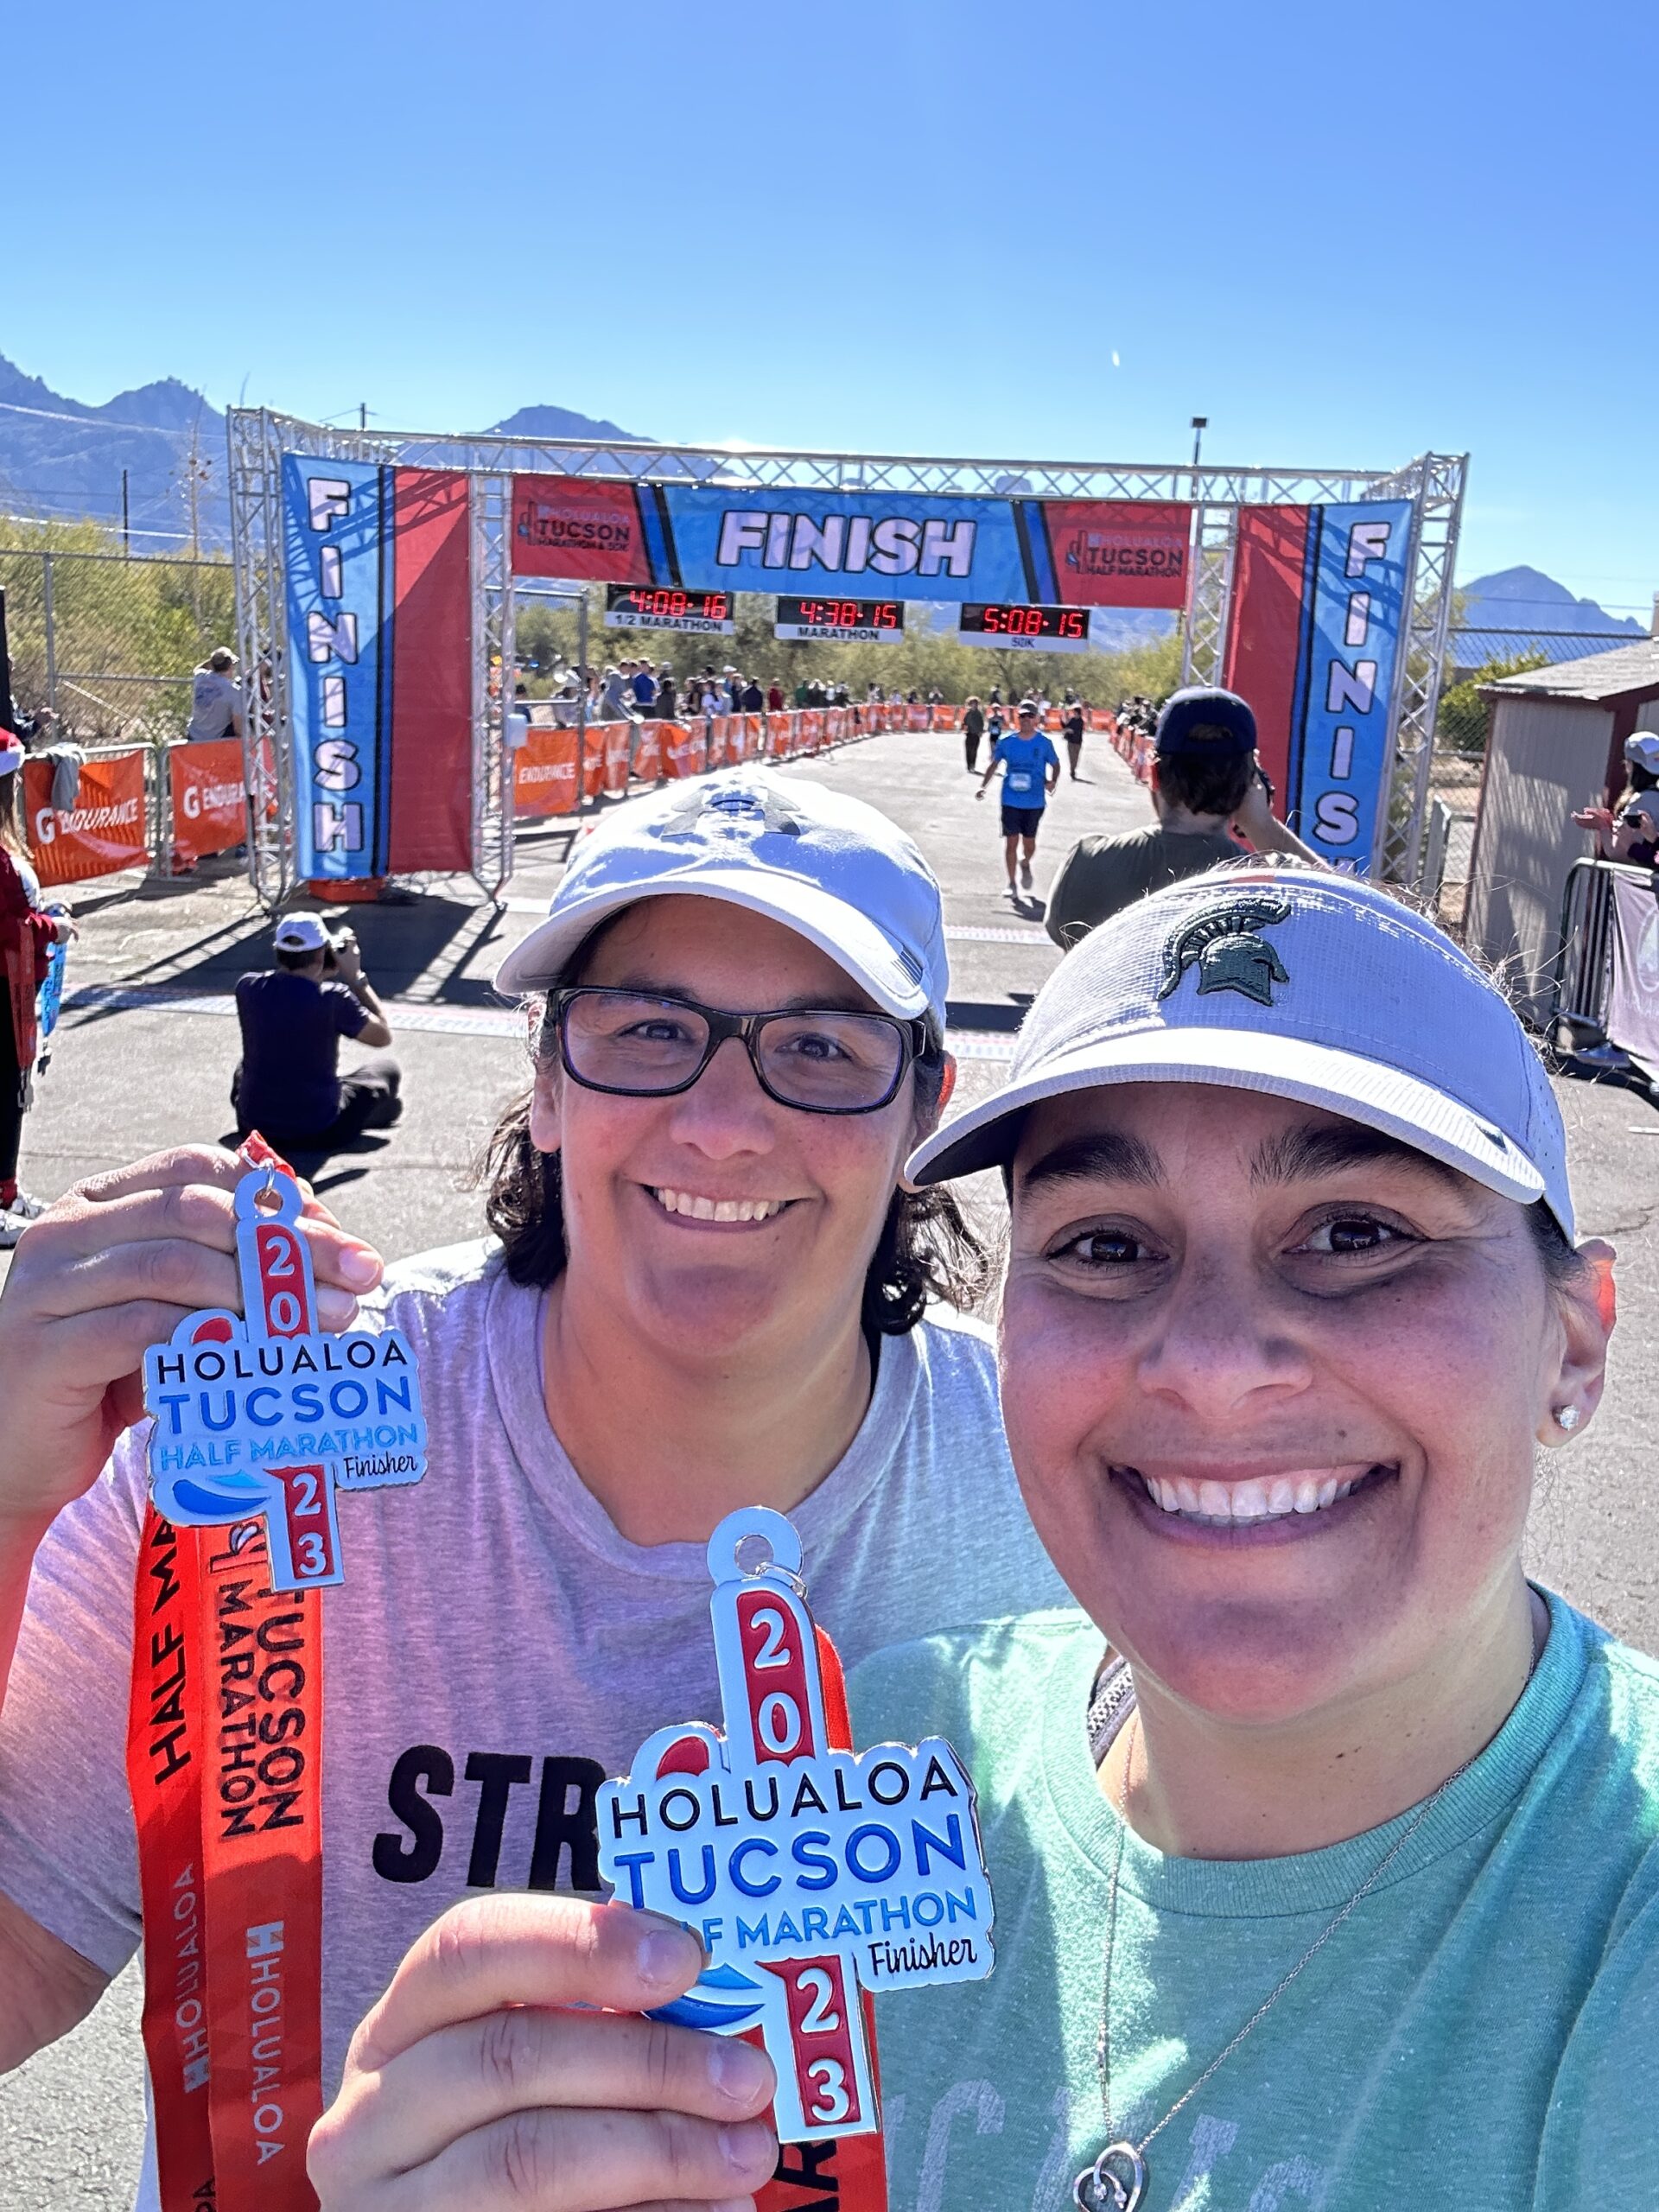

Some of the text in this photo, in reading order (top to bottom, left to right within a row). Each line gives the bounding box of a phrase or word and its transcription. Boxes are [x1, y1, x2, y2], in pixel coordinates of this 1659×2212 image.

[537, 519, 630, 541] TUCSON
[716, 510, 977, 577] FINISH
[1088, 547, 1184, 566] TUCSON
[1118, 566, 1182, 577] MARATHON
[641, 616, 722, 632] MARATHON
[798, 627, 880, 640] MARATHON
[308, 478, 364, 852] FINISH
[1313, 522, 1391, 871] FINIS
[157, 1338, 408, 1385] HOLUALOA
[159, 1375, 413, 1434] TUCSON
[161, 1424, 417, 1471] HALF MARATHON
[343, 1454, 418, 1479] Finisher
[149, 1623, 191, 1785] HALF
[217, 1579, 257, 1840] MARATHON
[258, 1588, 306, 1833] TUCSON
[612, 1755, 958, 1840] HOLUALOA
[613, 1814, 966, 1910] TUCSON
[735, 1885, 977, 1949] MARATHON
[173, 1861, 208, 2060] HOLUALOA
[868, 1932, 978, 1977] Finisher
[250, 1957, 285, 2165] HOLUALOA
